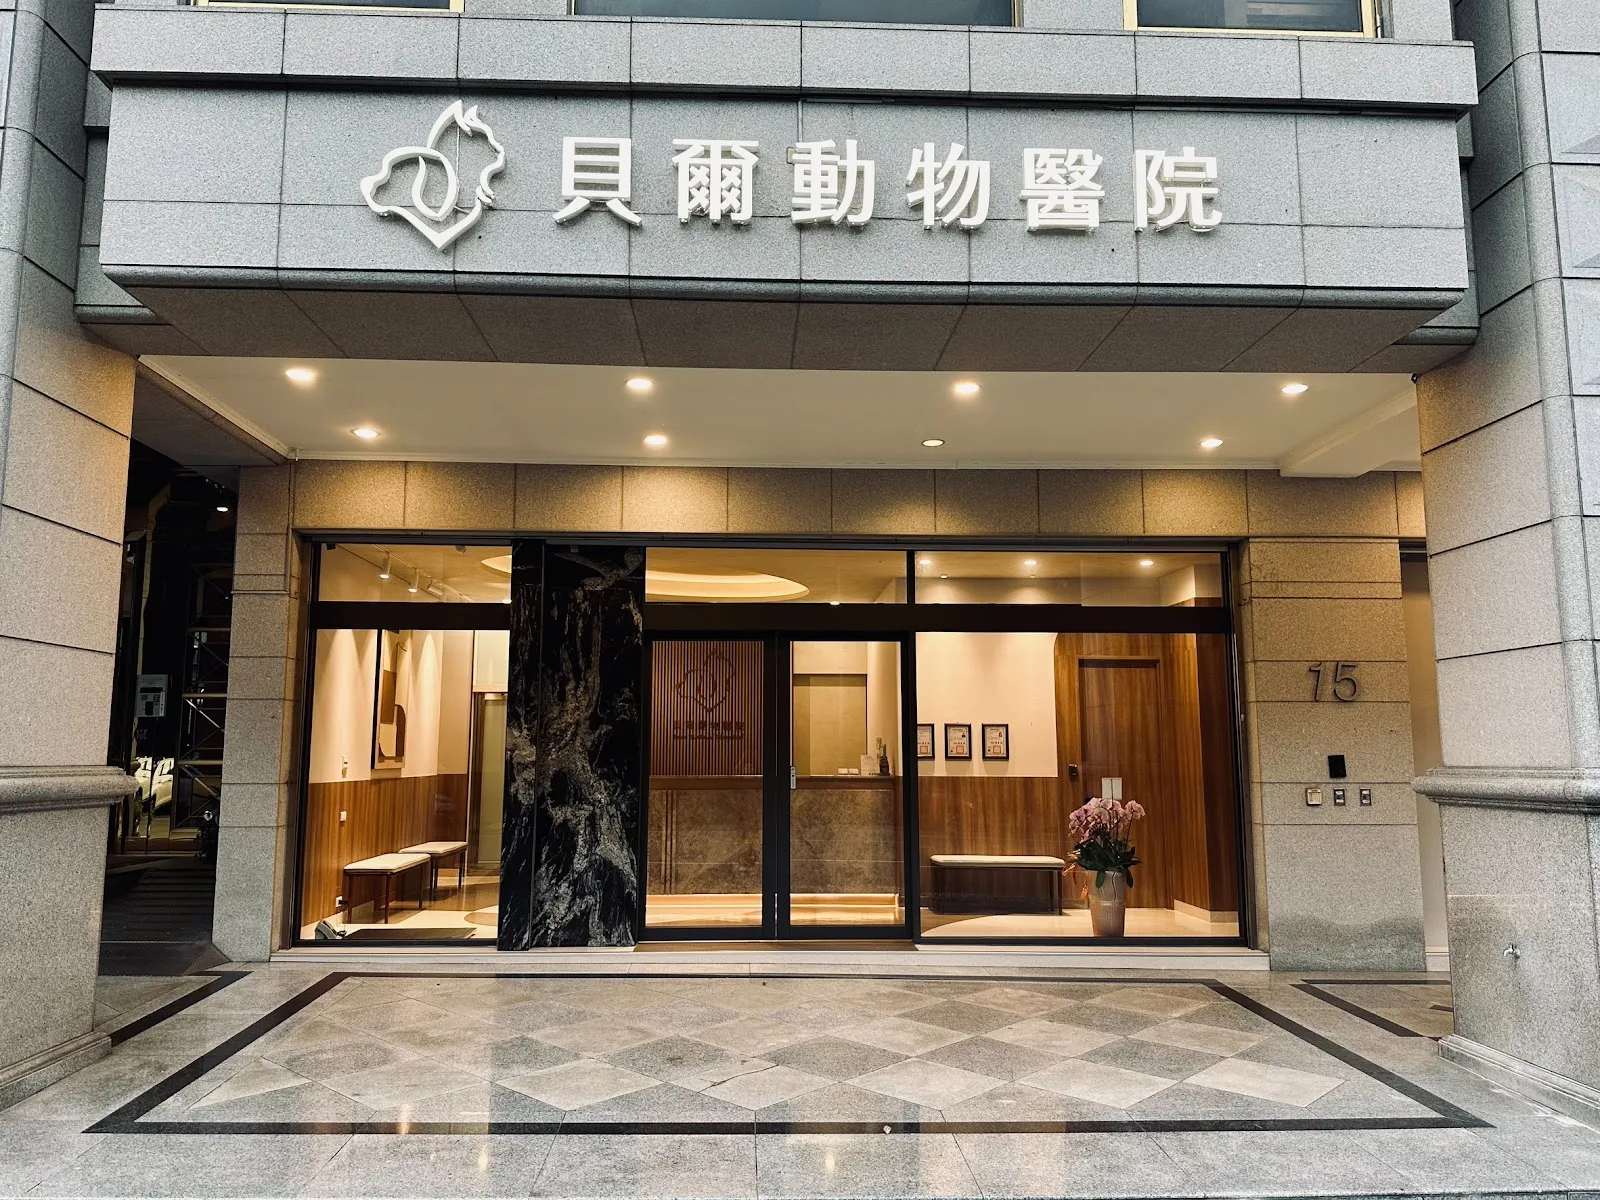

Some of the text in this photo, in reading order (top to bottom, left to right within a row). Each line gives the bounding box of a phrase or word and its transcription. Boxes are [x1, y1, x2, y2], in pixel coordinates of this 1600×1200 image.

[553, 136, 1222, 232] 貝爾動物醫院
[1308, 660, 1358, 702] 15
